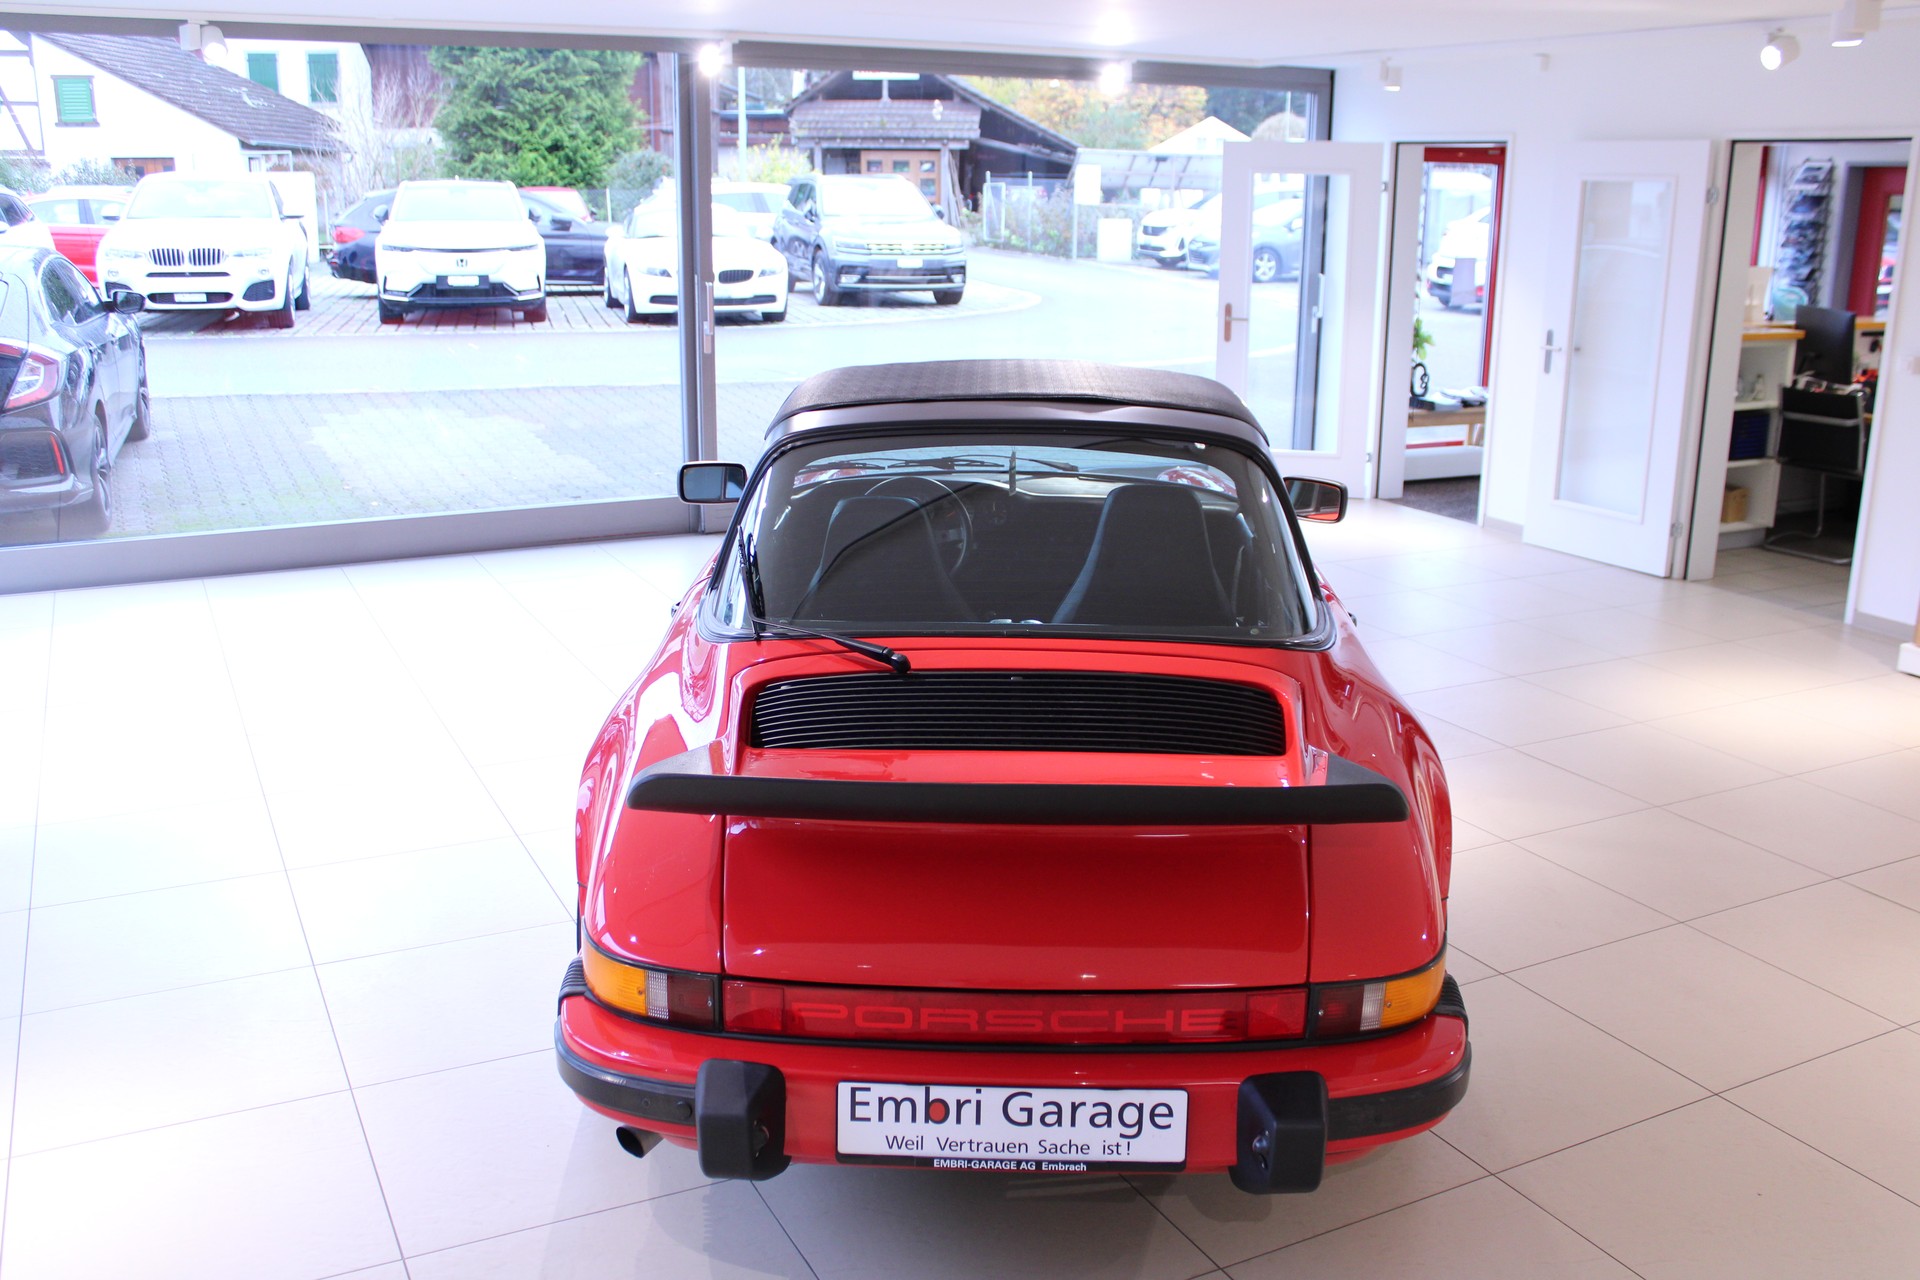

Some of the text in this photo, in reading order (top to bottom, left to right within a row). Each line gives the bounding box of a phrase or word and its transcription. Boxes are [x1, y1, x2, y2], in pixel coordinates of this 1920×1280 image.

[791, 1001, 1236, 1033] PORSCHE
[849, 1085, 1175, 1140] Embri Garage
[885, 1135, 925, 1151] Weil
[936, 1137, 1029, 1155] Vertrauen
[1038, 1139, 1091, 1156] Sache
[933, 1158, 1087, 1172] EMBRI-GARAGE AG Embrach
